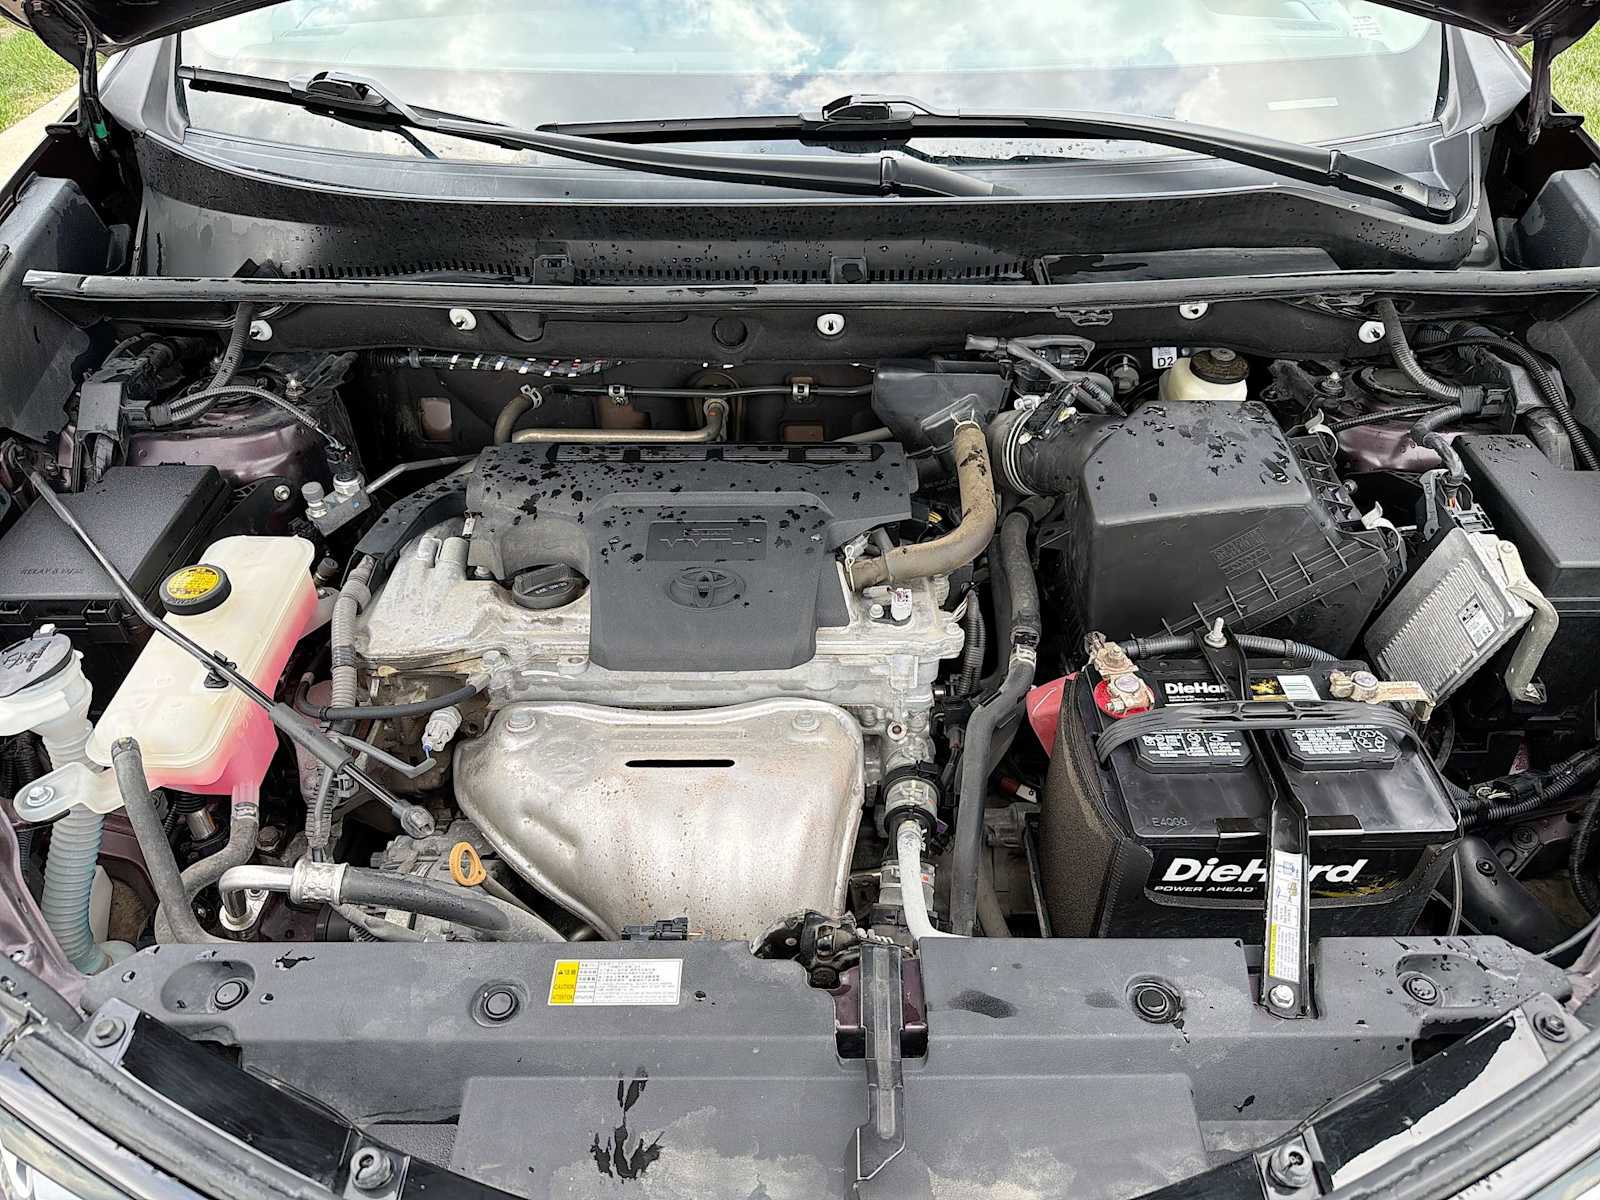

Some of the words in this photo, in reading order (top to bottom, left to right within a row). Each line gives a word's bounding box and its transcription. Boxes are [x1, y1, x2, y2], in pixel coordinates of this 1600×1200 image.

[1157, 357, 1174, 367] D2
[1162, 857, 1369, 883] DieHrd
[1153, 885, 1203, 893] POWER
[1206, 885, 1255, 893] AHEAD
